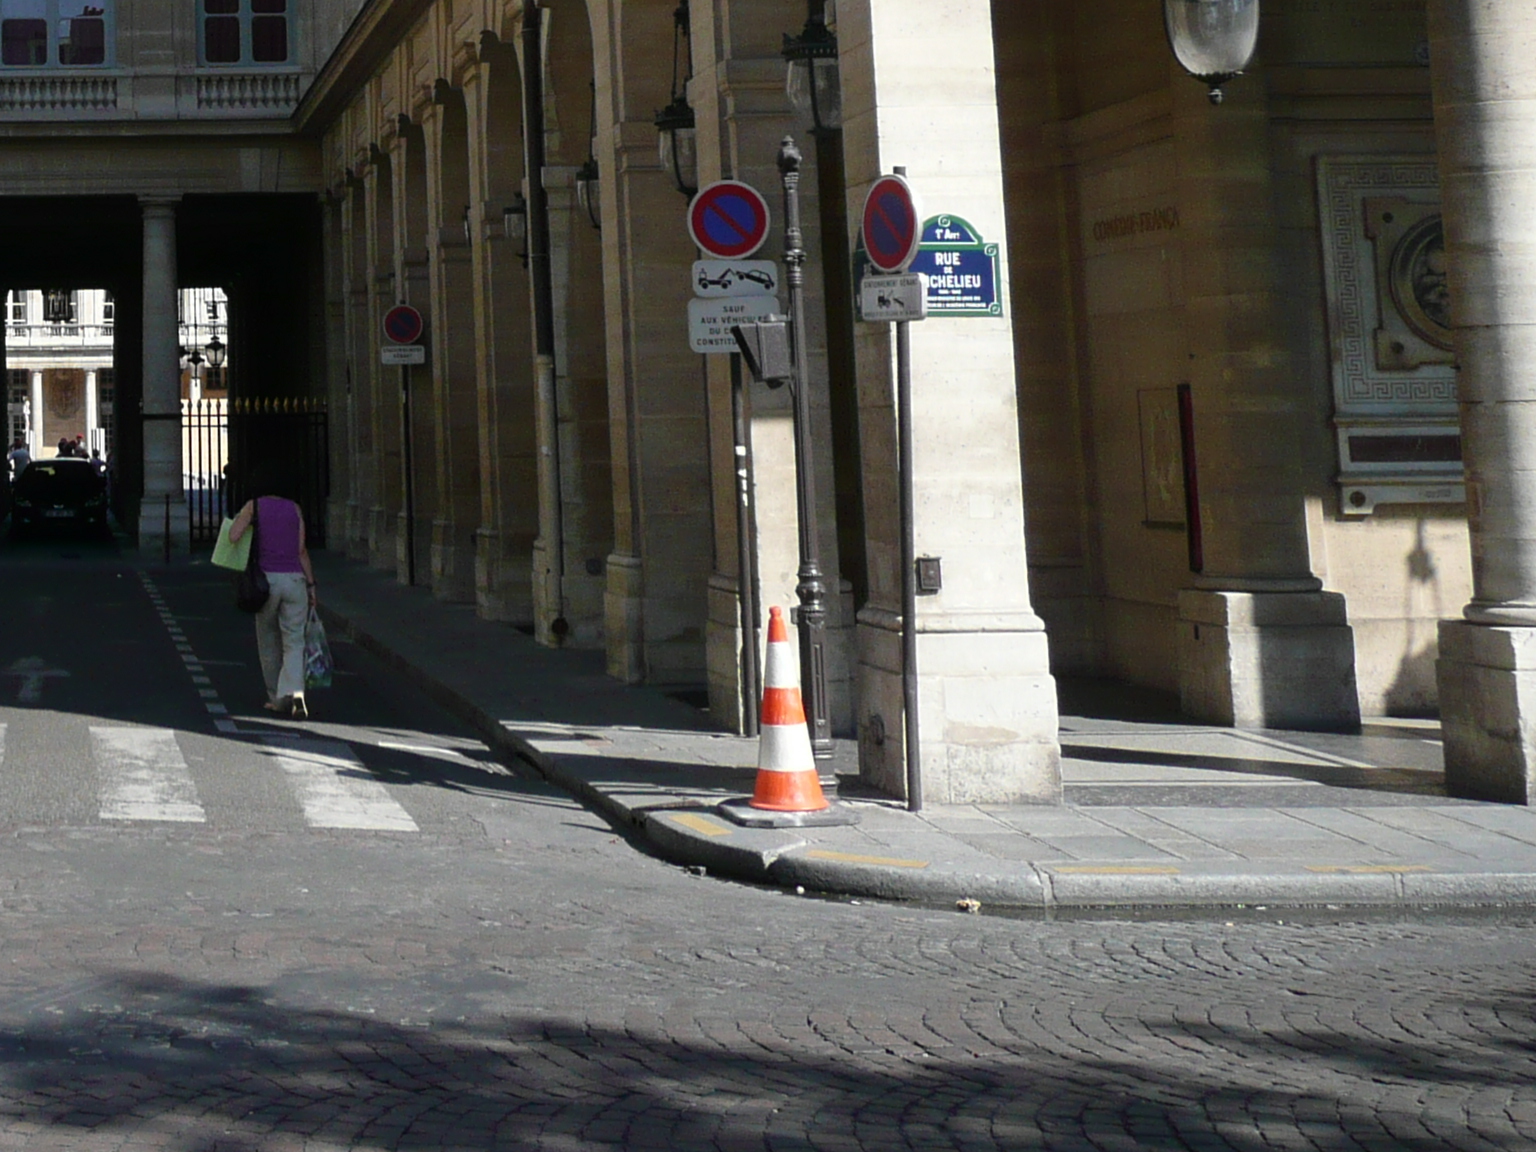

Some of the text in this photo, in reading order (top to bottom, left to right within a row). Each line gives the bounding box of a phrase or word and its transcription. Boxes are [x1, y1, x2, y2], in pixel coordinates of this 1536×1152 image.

[935, 252, 961, 266] RUE
[926, 275, 981, 288] ICHELIEU
[722, 305, 745, 313] SAUF
[700, 316, 717, 324] AUX
[709, 327, 721, 335] DU
[696, 338, 738, 346] CONSTITU
